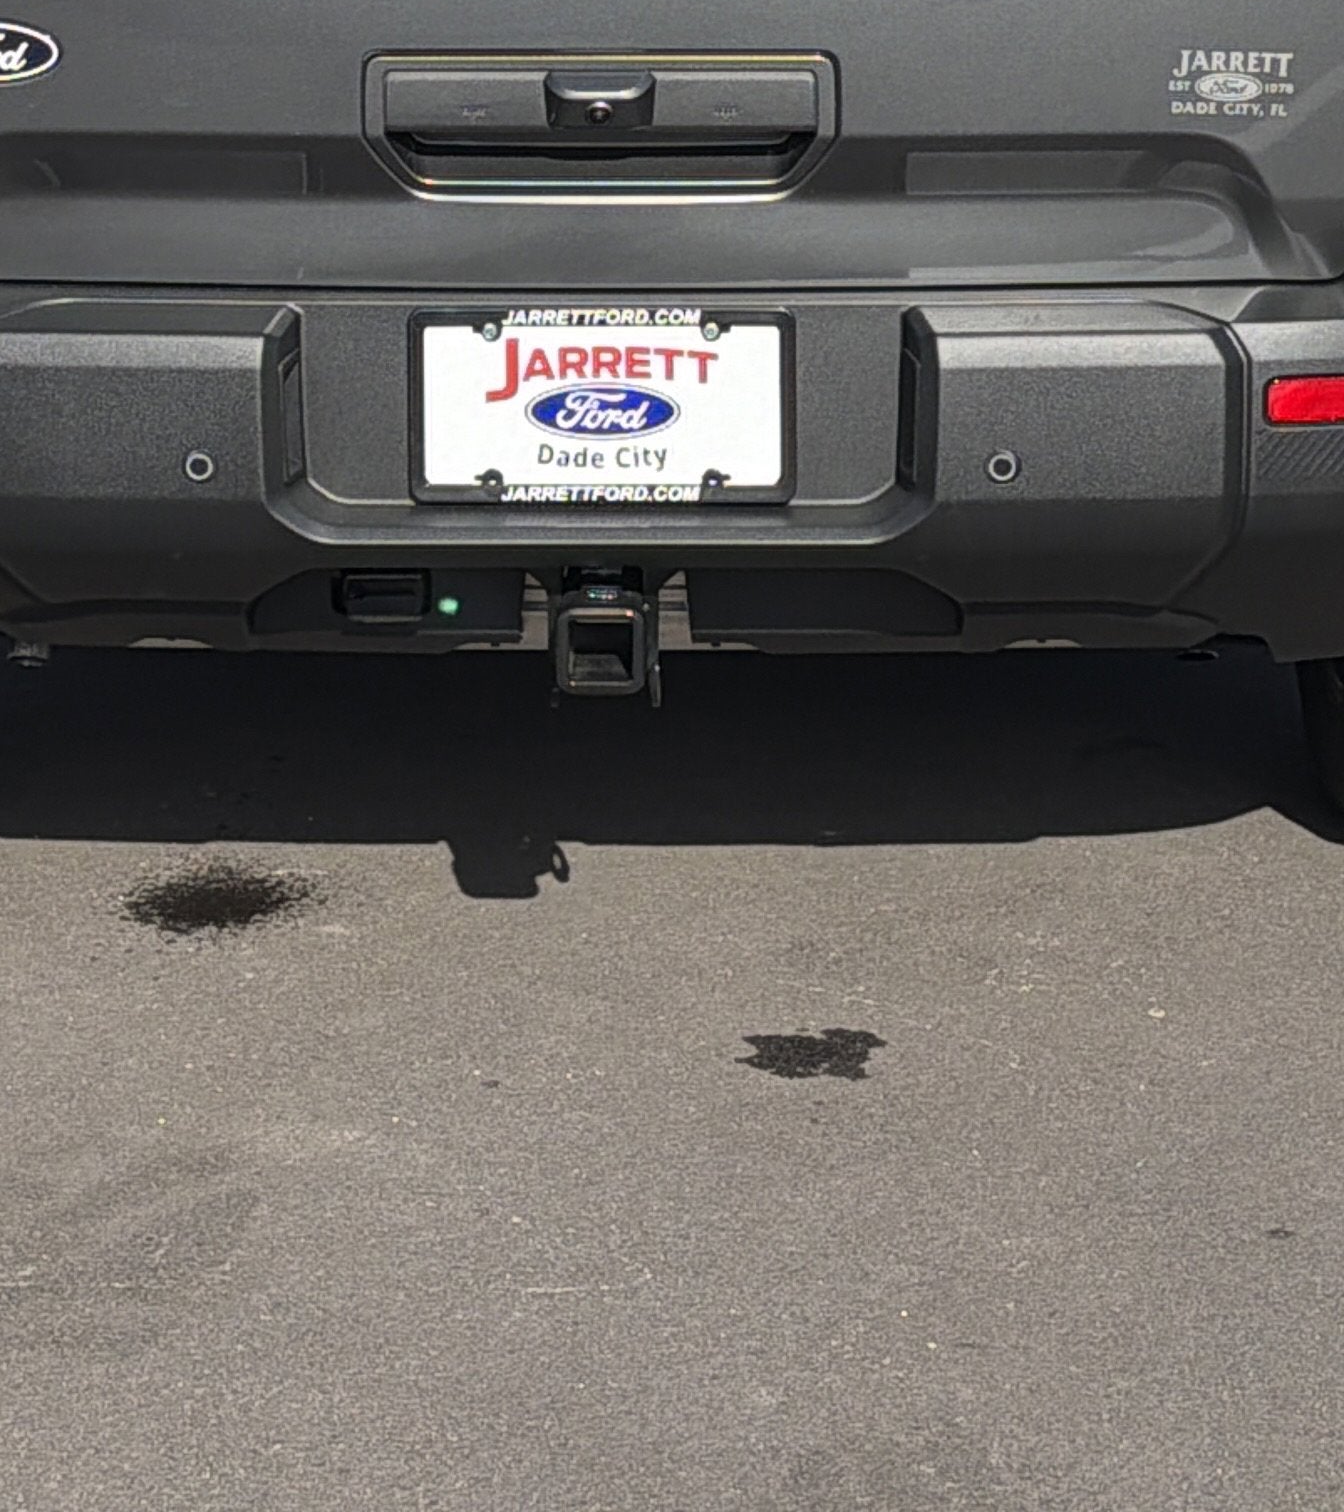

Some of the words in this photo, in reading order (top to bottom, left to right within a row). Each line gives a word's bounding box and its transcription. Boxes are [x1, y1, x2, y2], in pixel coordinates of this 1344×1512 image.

[1172, 49, 1295, 78] JARRETT
[1167, 80, 1192, 92] EST
[1170, 101, 1218, 115] DADE
[1223, 102, 1264, 118] CITY,
[1269, 103, 1288, 117] FL
[501, 308, 702, 326] JARRETTFORD.COM
[485, 337, 720, 403] JARRETT
[555, 391, 651, 430] Ford
[537, 443, 605, 469] Dade
[615, 445, 669, 472] City
[501, 485, 701, 502] JARRETTFORD.COM
